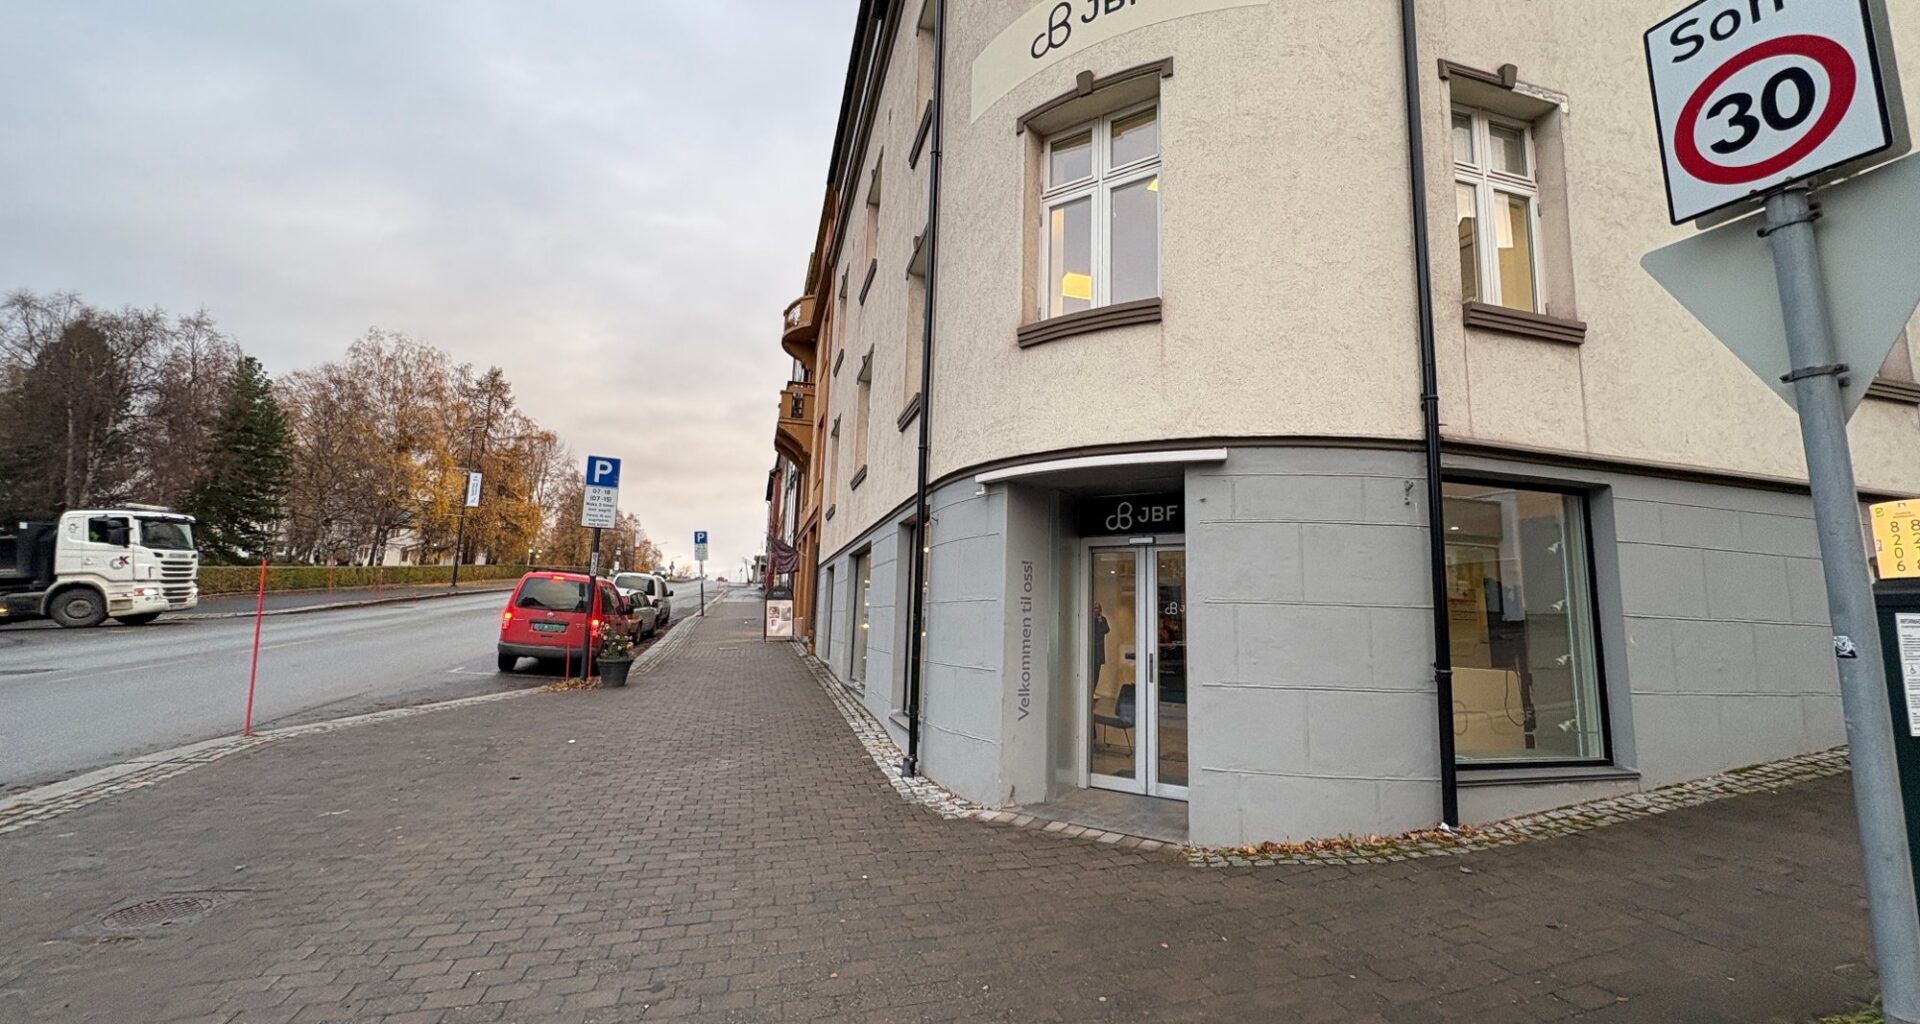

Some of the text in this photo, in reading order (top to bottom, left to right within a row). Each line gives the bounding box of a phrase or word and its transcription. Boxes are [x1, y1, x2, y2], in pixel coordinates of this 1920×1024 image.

[1706, 66, 1816, 154] 30
[594, 460, 613, 483] P
[1137, 505, 1178, 523] JBF
[697, 532, 705, 543] P
[1018, 560, 1033, 721] Velkommen til oss!
